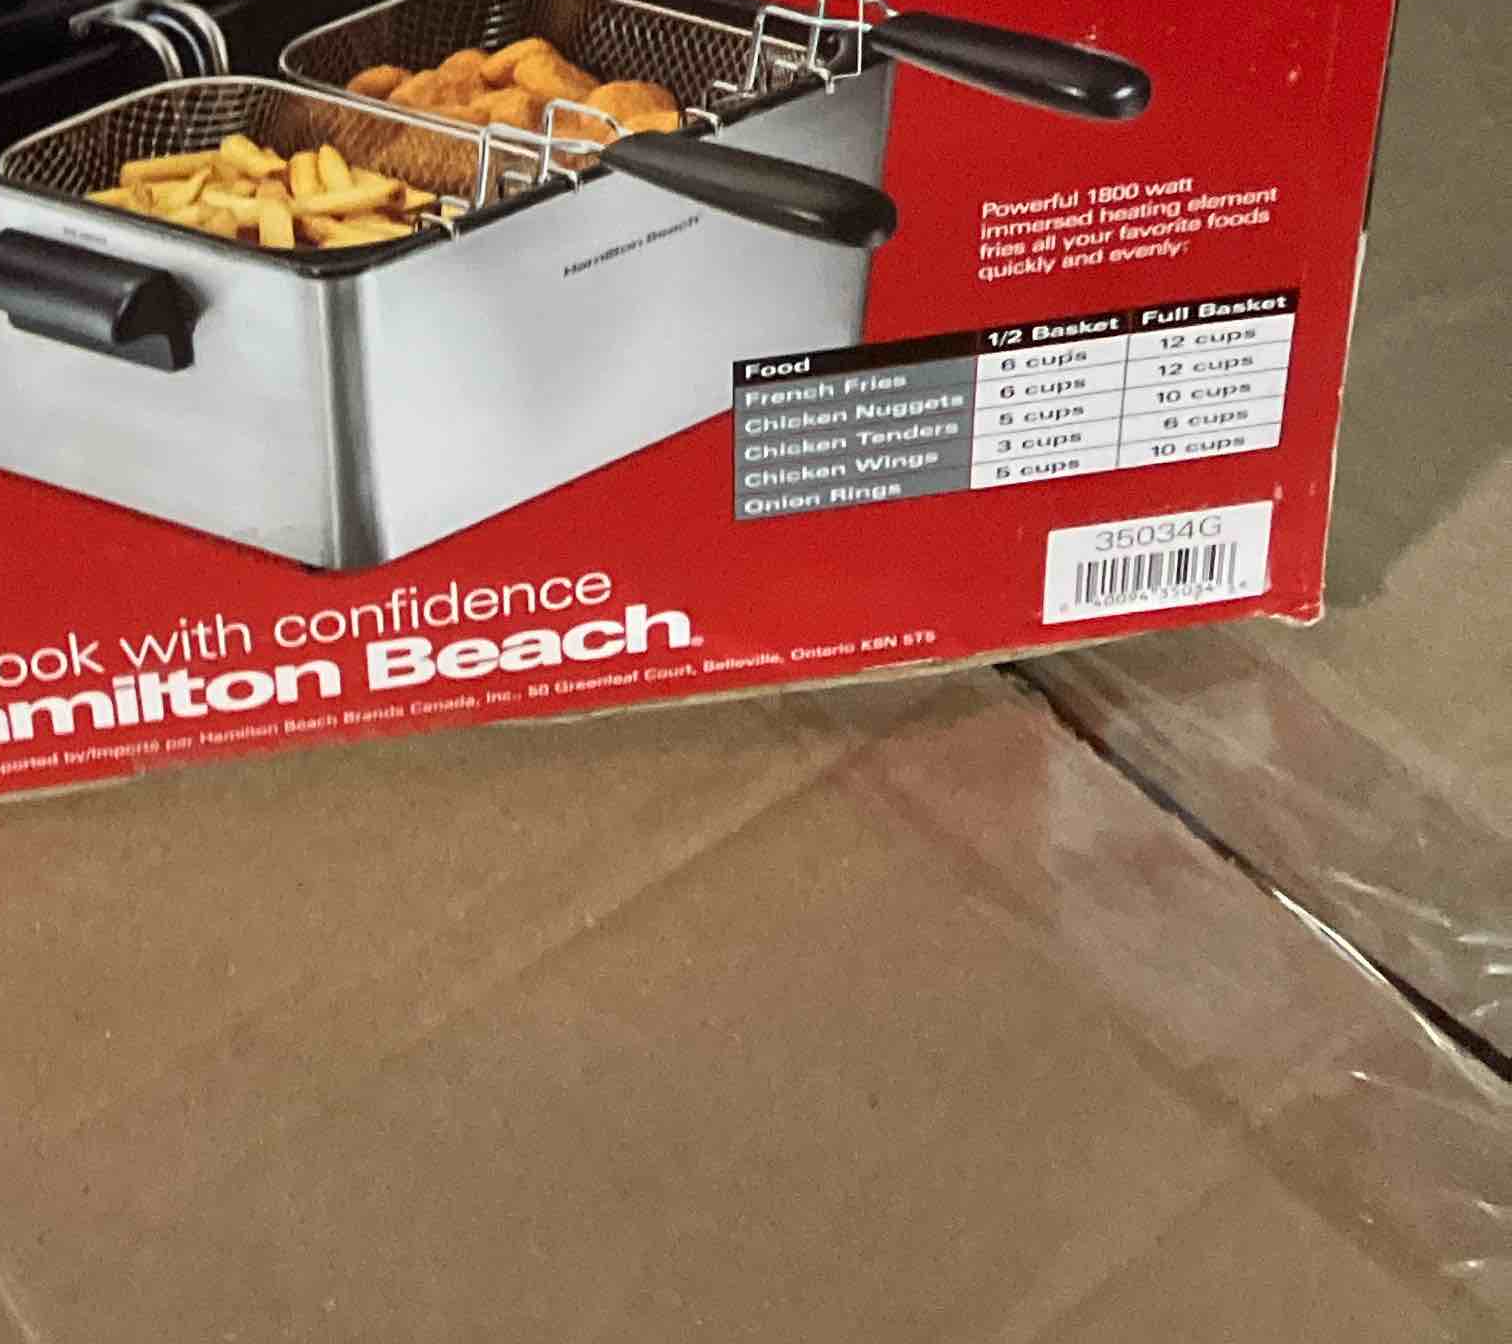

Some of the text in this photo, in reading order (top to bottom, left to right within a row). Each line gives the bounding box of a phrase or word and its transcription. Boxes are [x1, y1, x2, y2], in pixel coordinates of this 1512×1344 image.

[980, 187, 1278, 240] immersed heating element
[982, 177, 1193, 219] Powerful 1800 watt
[979, 208, 1270, 261] fries all your favorite foods
[977, 256, 1056, 282] quickly
[1061, 249, 1103, 269] and
[988, 317, 1120, 348] 1/2 Basket
[1142, 295, 1287, 326] Full Basket
[745, 382, 834, 408] French
[844, 375, 907, 395] Fries
[1026, 349, 1088, 369] cups
[1160, 335, 1185, 350] 12
[1195, 327, 1257, 346] cups
[745, 357, 810, 380] Food
[744, 355, 1254, 434] Chicken Nuggets 6 cups 12 cups
[744, 437, 847, 461] Chicken
[856, 422, 959, 447] Tenders
[1024, 404, 1085, 424] cups
[1156, 390, 1182, 404] 10
[1191, 382, 1251, 401] cups
[744, 463, 846, 488] Chicken
[855, 450, 939, 473] Wings
[997, 439, 1012, 453] 3
[1022, 431, 1082, 451] cups
[1187, 408, 1249, 428] cups
[744, 493, 821, 514] Onion
[830, 483, 902, 502] Rings
[1020, 458, 1080, 478] cups
[1151, 443, 1176, 457] 10
[1185, 435, 1245, 455] cups
[1095, 514, 1222, 552] 35034G
[119, 613, 252, 670] with
[274, 570, 612, 647] confidence
[200, 723, 278, 745] Hamilton
[284, 714, 338, 735] Beach
[344, 705, 405, 725] Brands
[790, 640, 855, 662] Ontario
